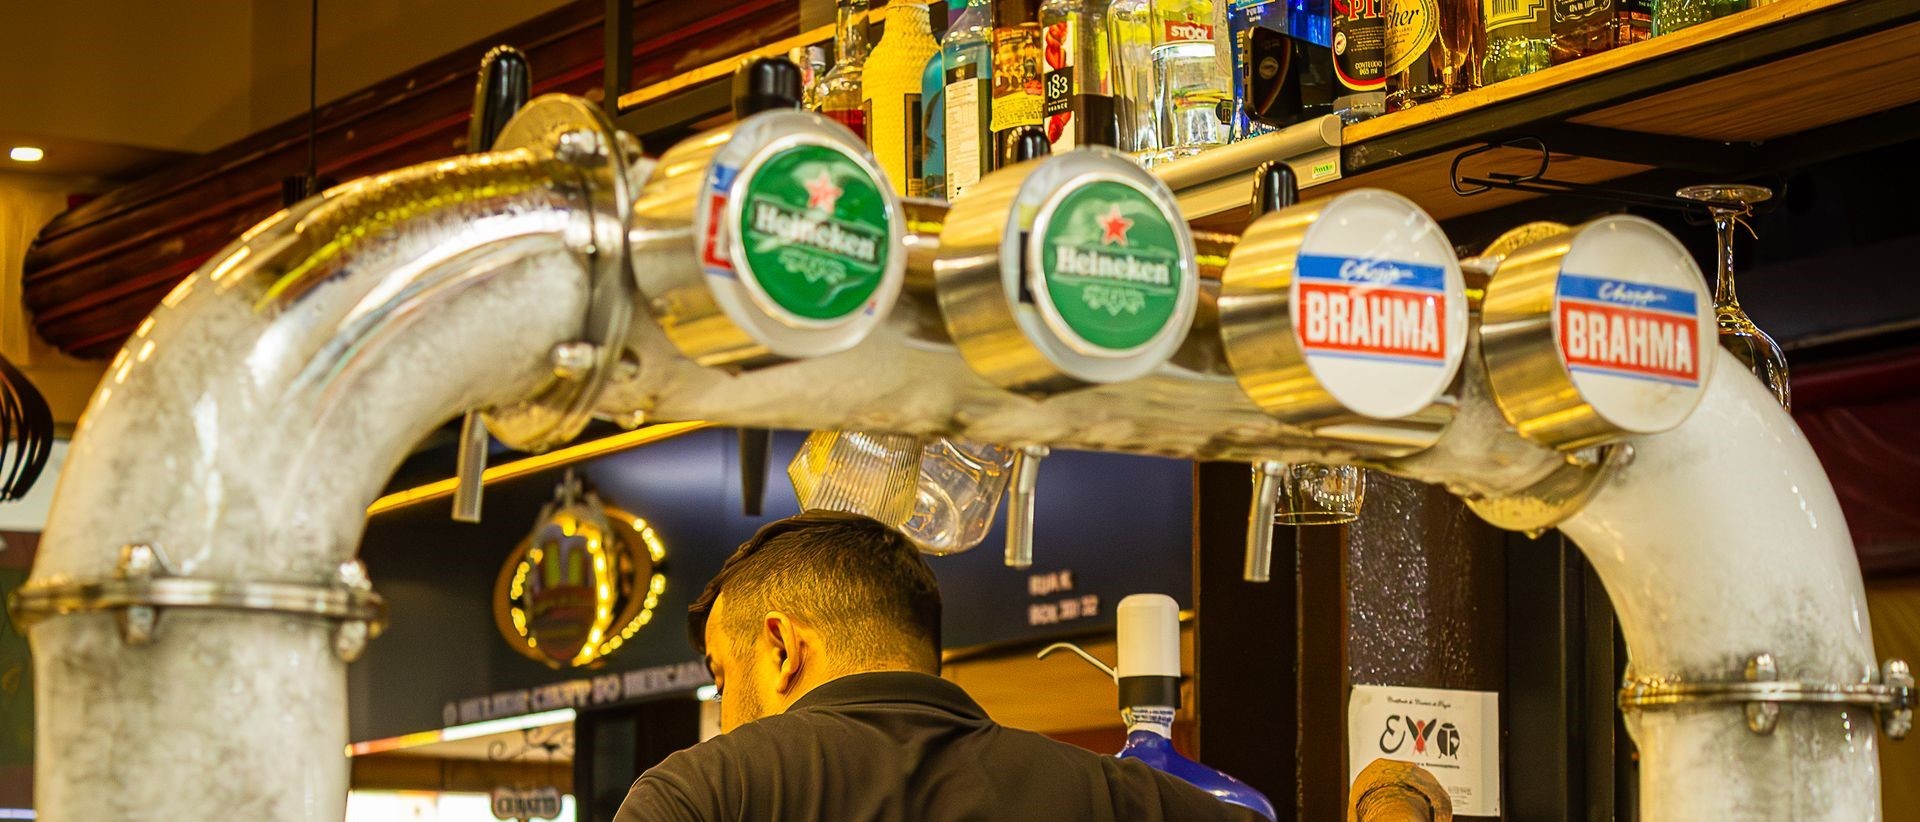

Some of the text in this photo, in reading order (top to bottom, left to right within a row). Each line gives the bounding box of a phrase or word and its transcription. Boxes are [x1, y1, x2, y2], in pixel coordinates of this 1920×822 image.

[1170, 25, 1208, 41] STOCK
[755, 203, 876, 262] Heineken
[1055, 245, 1170, 285] Heineken
[1305, 291, 1440, 353] BRAHMA
[1567, 310, 1693, 374] BRAHMA
